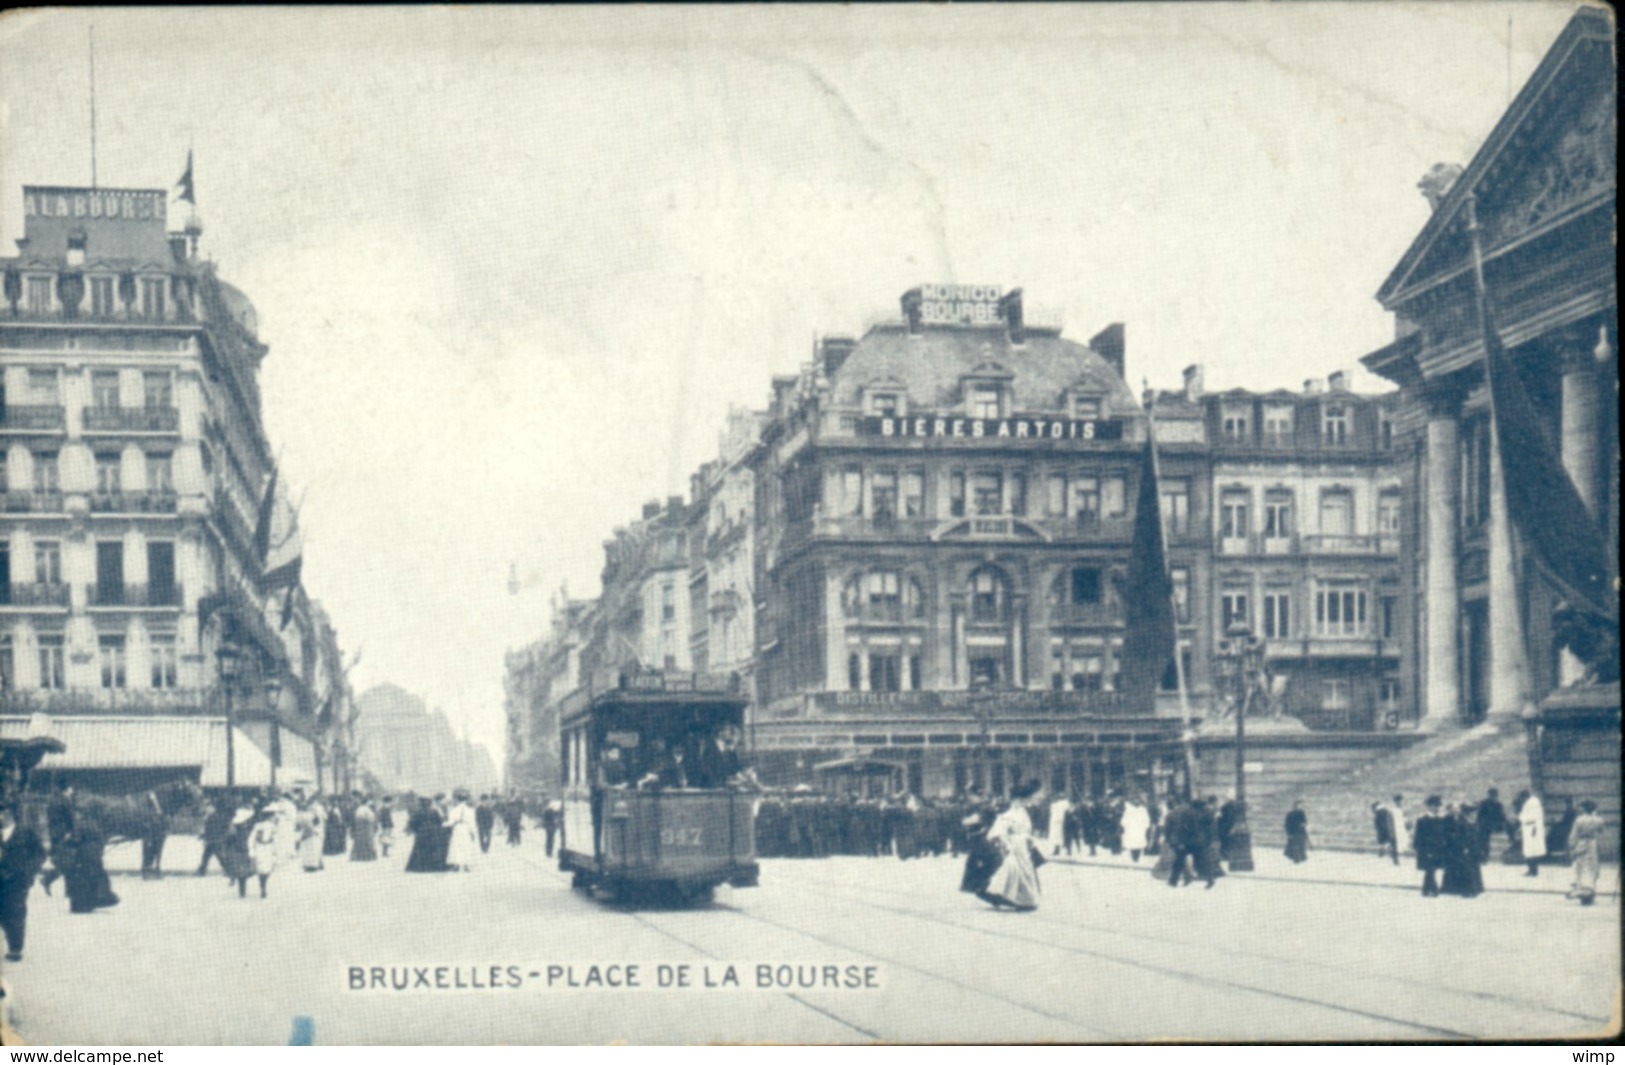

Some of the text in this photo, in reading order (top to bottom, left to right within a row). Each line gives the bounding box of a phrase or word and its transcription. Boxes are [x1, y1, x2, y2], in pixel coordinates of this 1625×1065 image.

[921, 284, 1000, 300] MONICO
[921, 302, 999, 319] BOURSE
[998, 419, 1096, 438] ARTOIS
